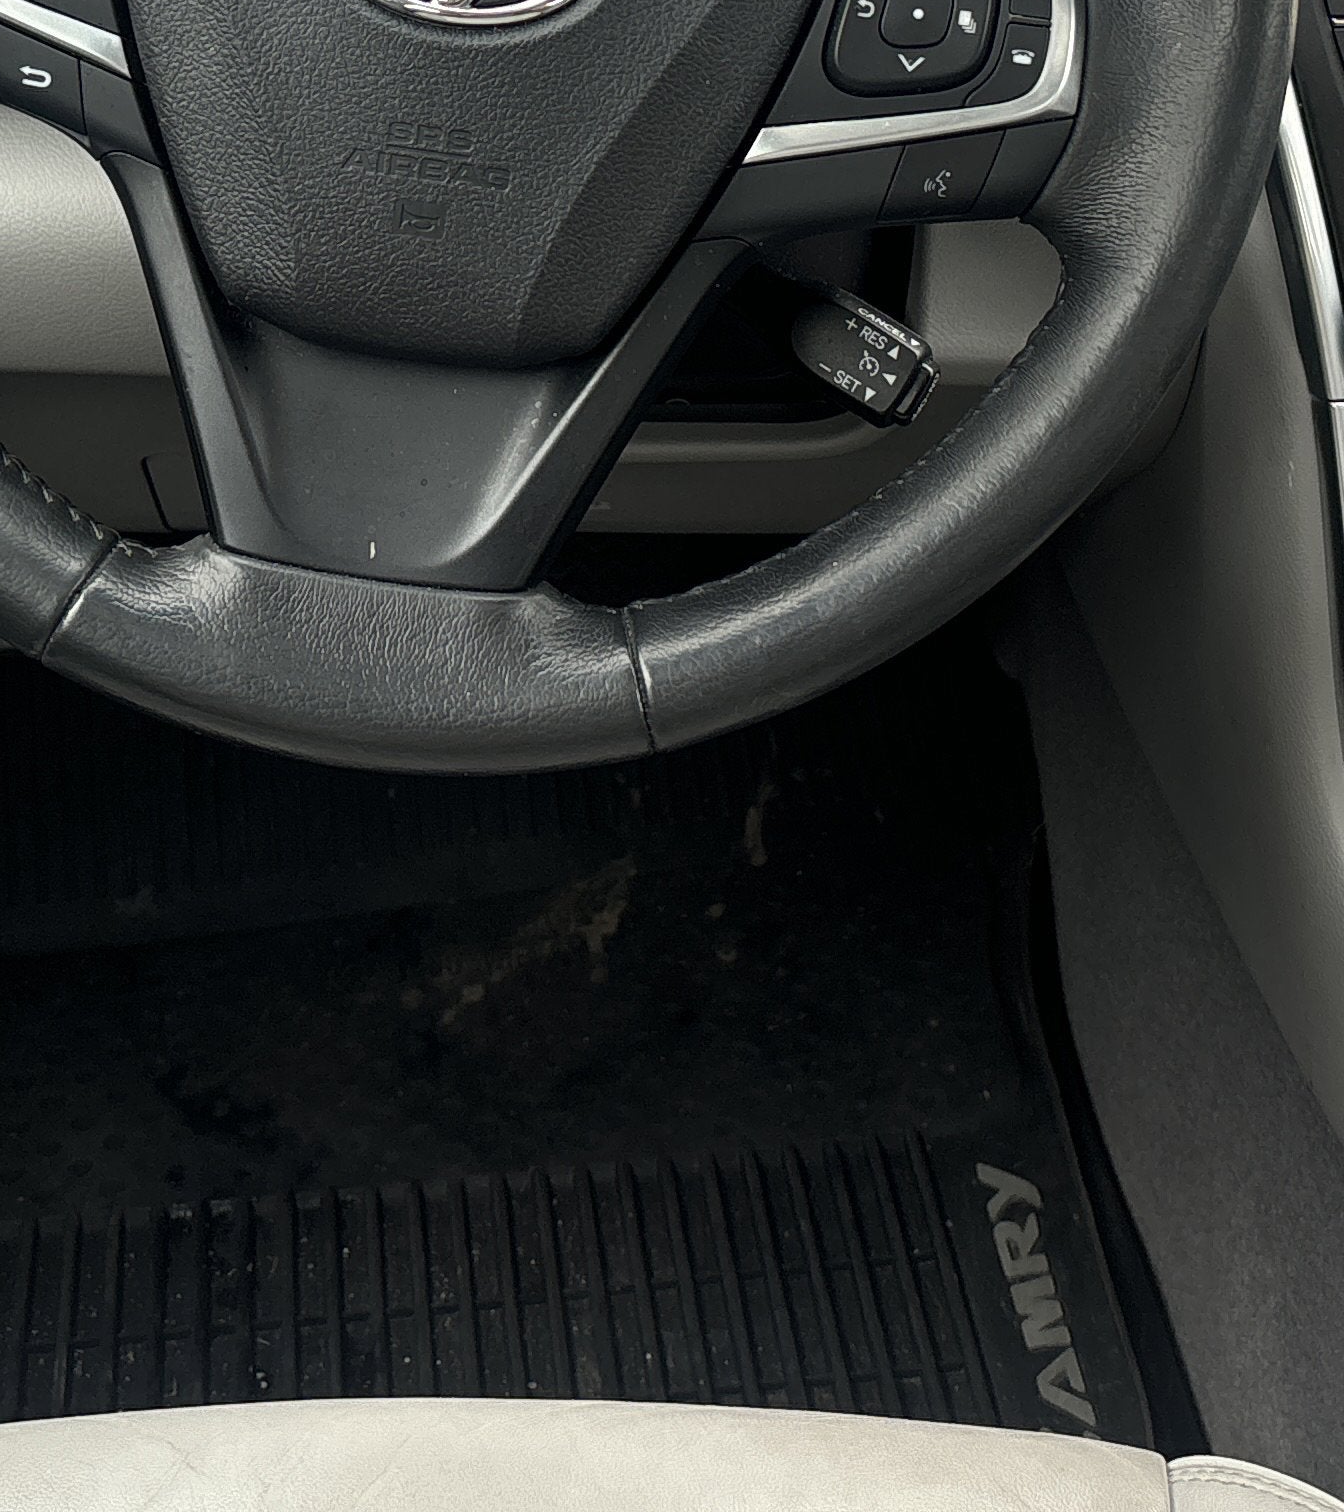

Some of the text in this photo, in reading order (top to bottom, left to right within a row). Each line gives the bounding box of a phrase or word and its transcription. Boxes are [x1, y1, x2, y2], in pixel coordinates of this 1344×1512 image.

[857, 307, 907, 342] CANCEL
[858, 325, 889, 350] RES
[833, 370, 862, 393] SET
[975, 1162, 1102, 1440] AMRY
